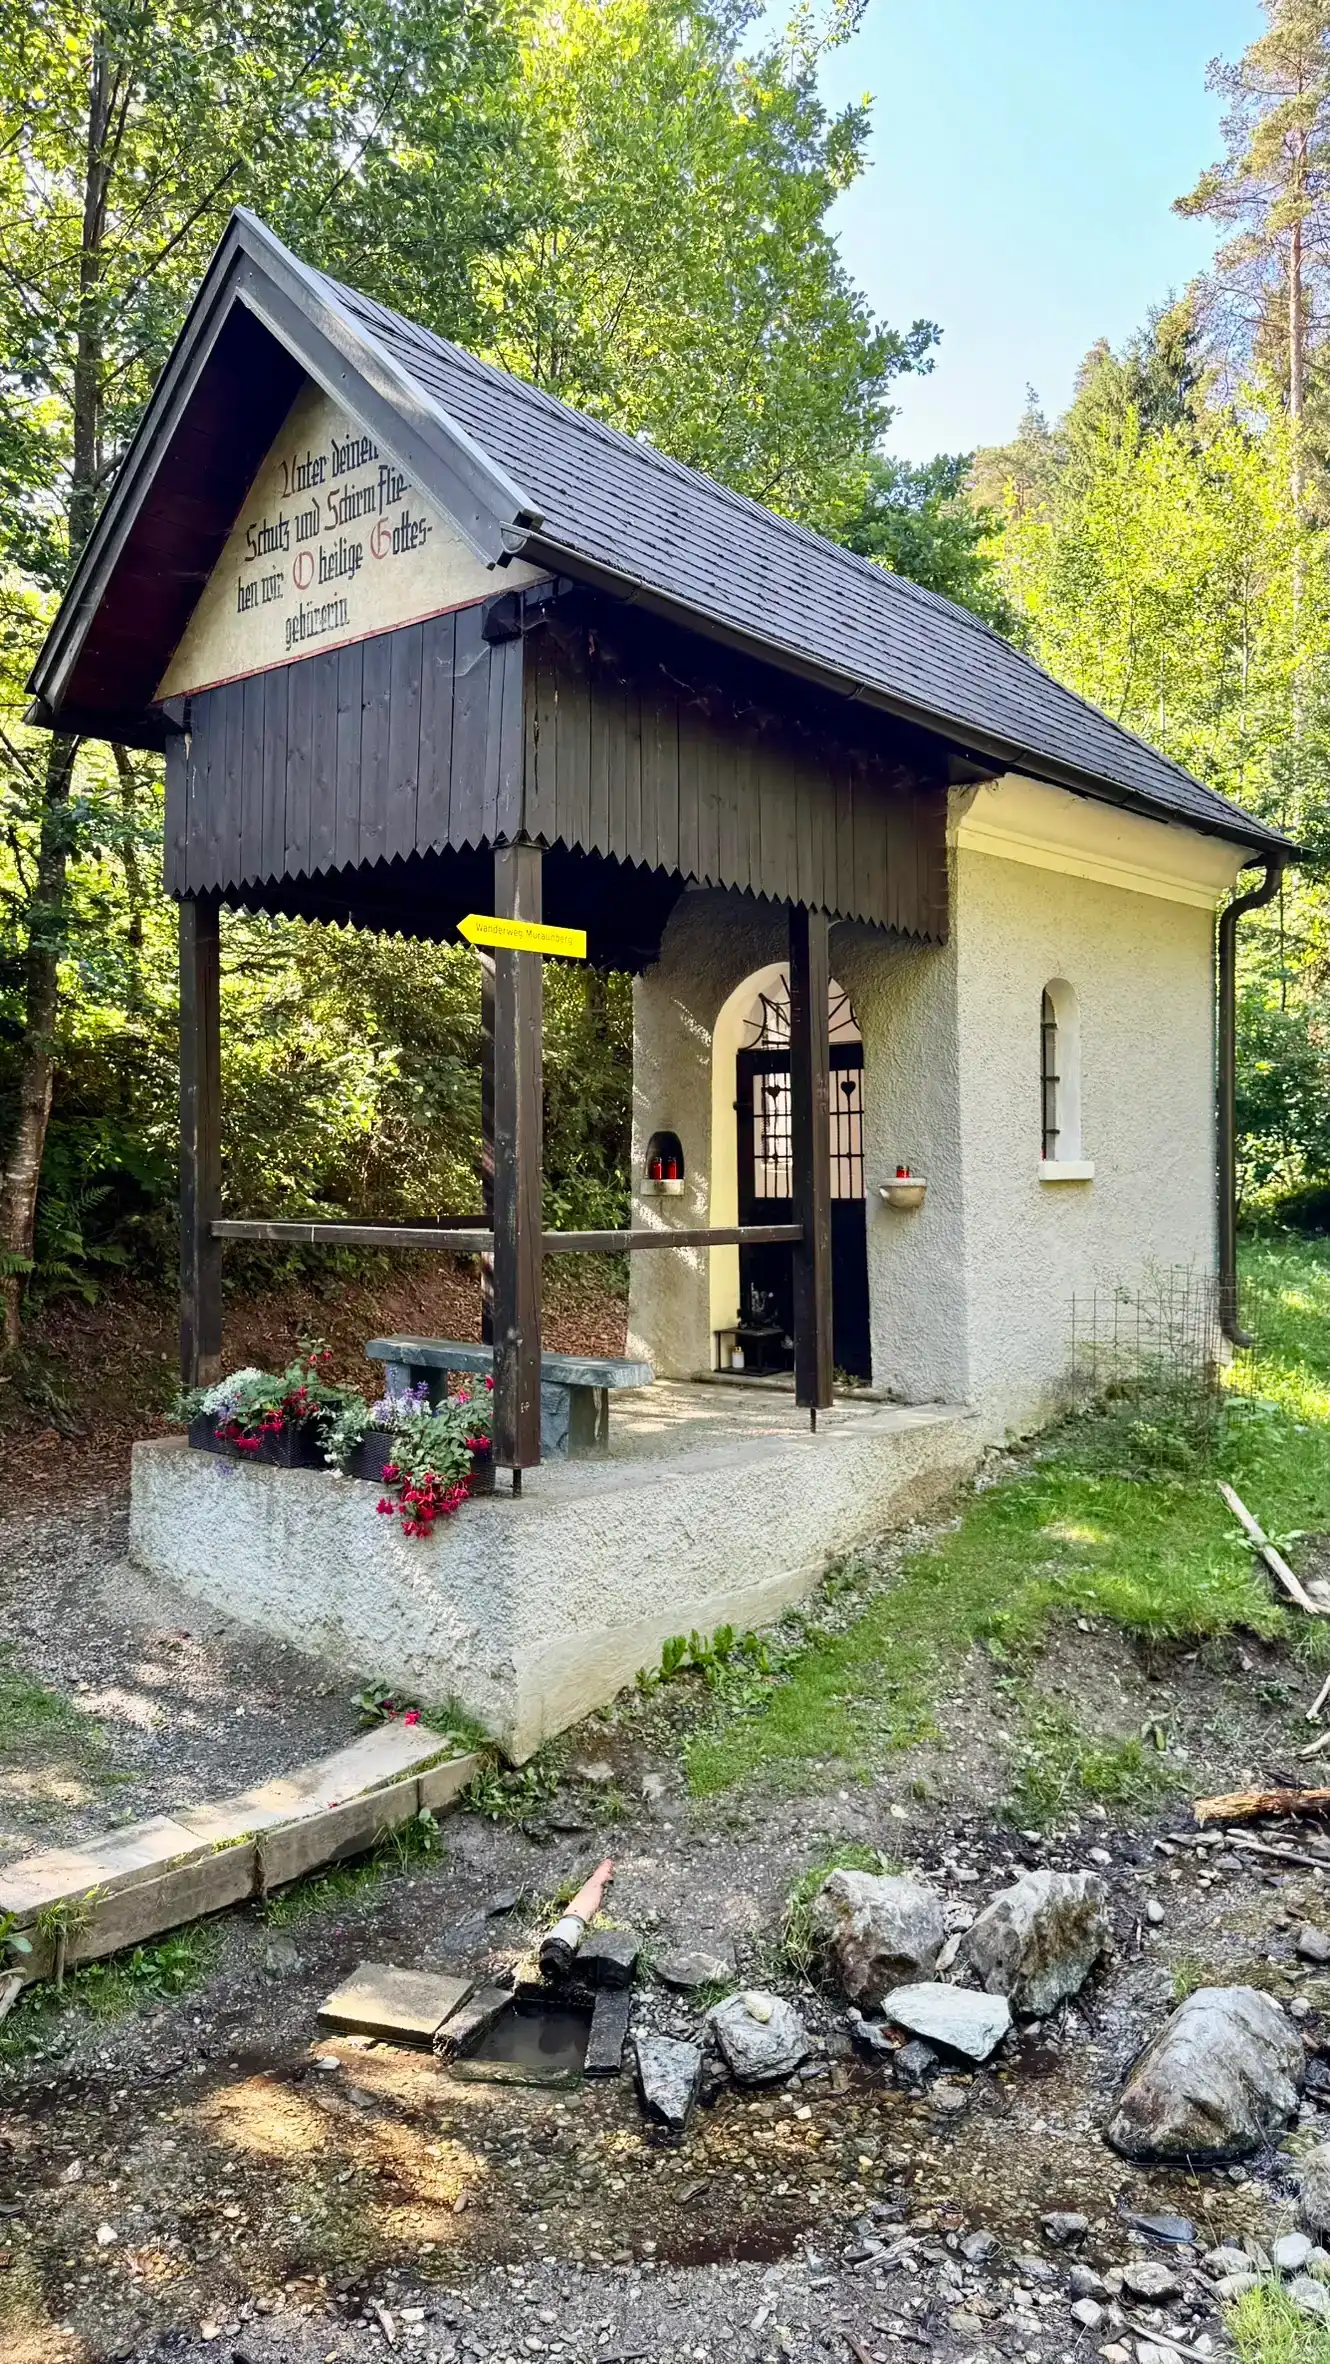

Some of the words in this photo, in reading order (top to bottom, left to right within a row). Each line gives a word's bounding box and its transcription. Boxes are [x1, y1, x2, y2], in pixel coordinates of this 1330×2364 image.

[280, 451, 327, 498] Unter
[245, 512, 290, 562] Schutz
[295, 497, 320, 542] und
[324, 484, 376, 530] Schirm
[237, 576, 259, 613] hen
[318, 538, 363, 584] heilige
[476, 922, 523, 939] Wanderweg
